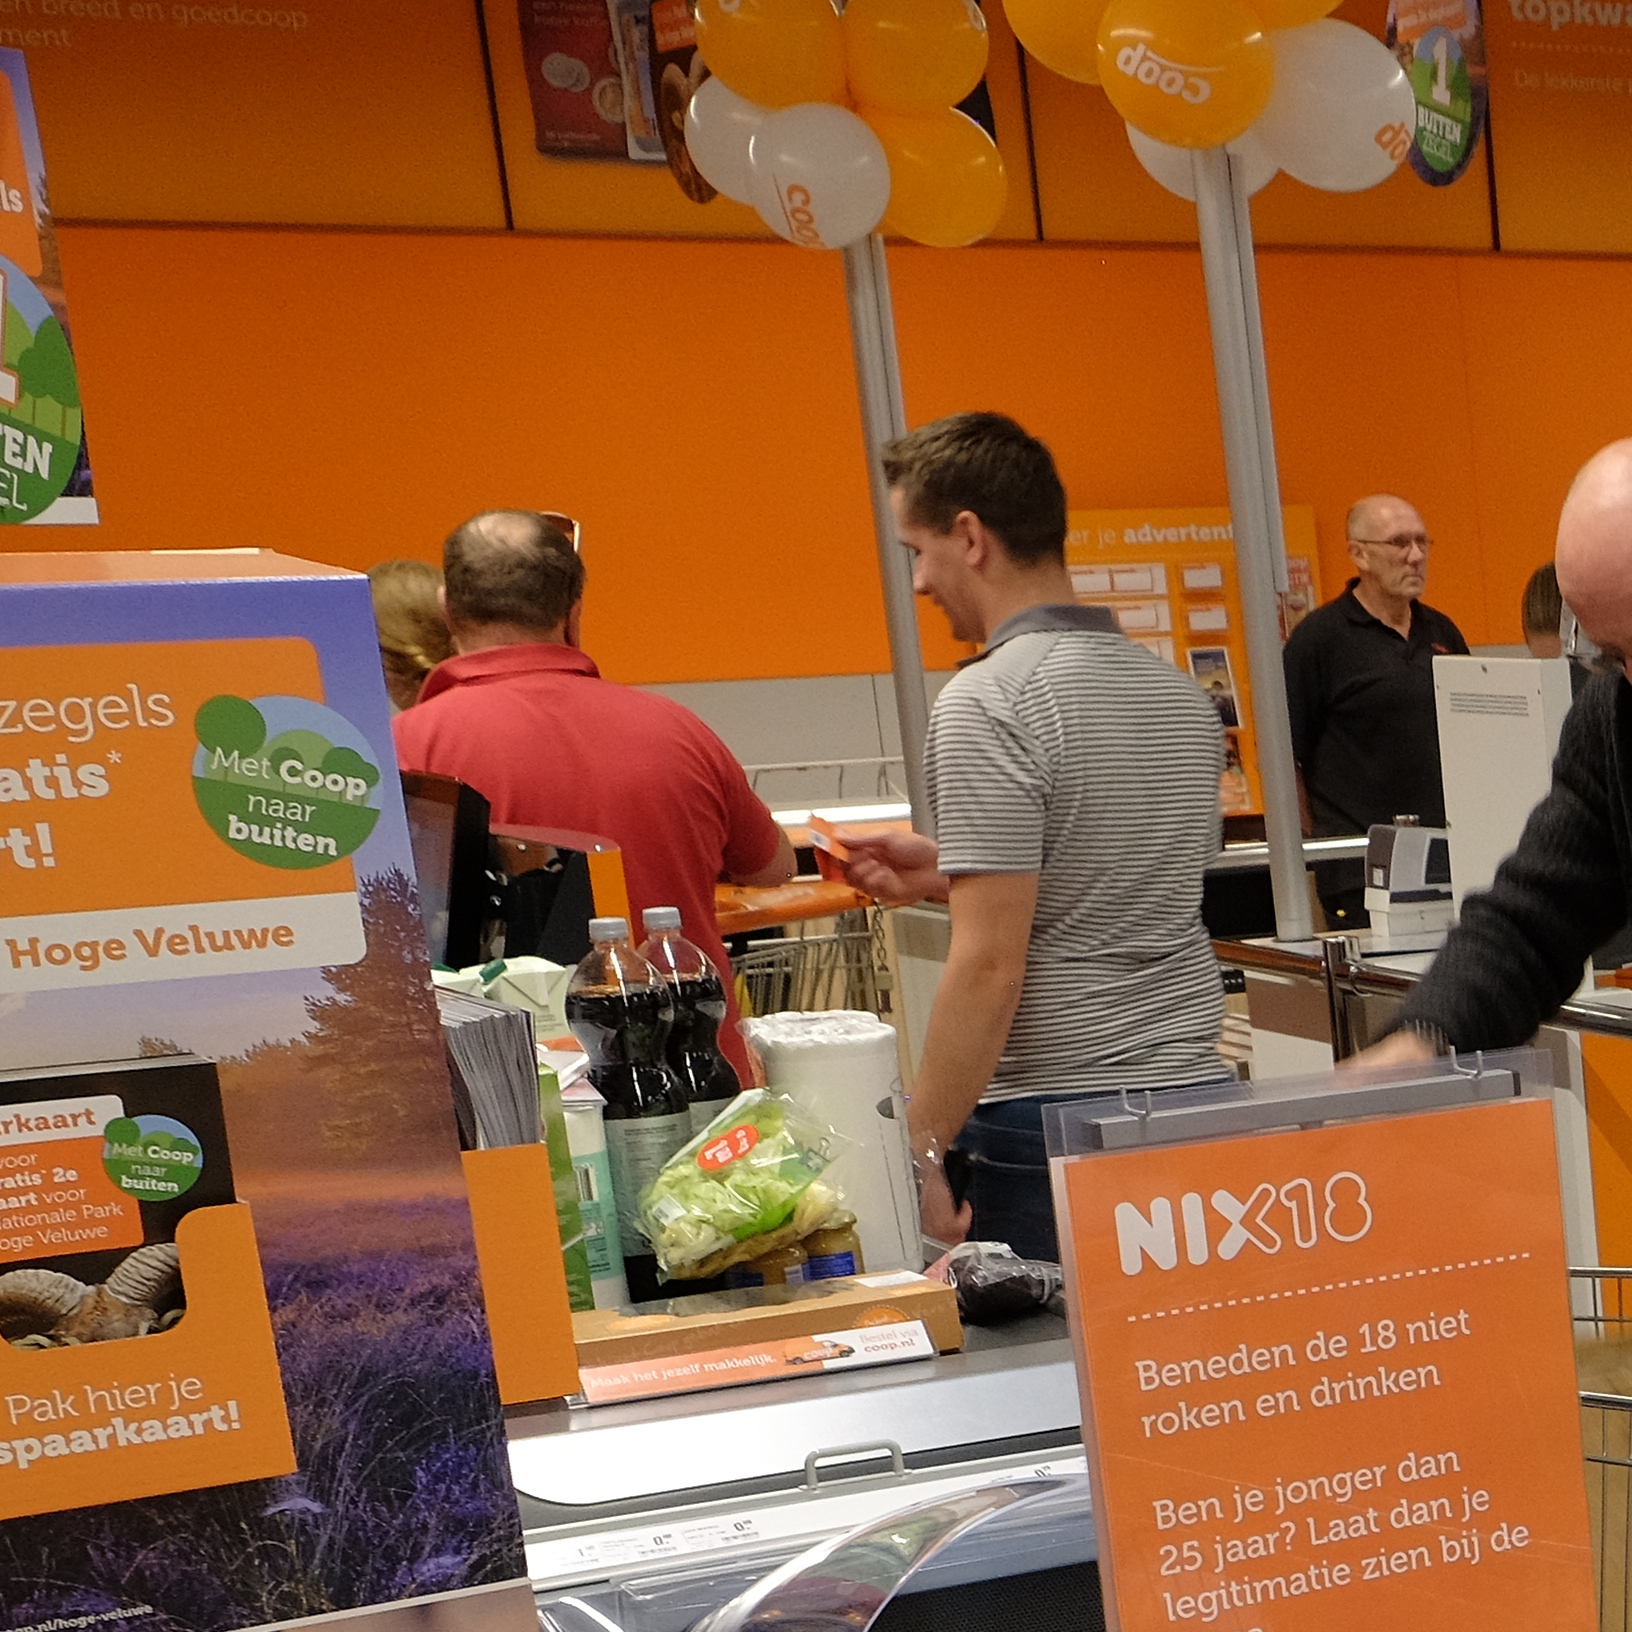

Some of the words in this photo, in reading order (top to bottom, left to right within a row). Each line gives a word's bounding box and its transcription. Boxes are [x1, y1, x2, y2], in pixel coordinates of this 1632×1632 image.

[1116, 42, 1212, 105] coop
[1417, 106, 1461, 146] BUITEN
[211, 746, 271, 780] Met
[278, 758, 369, 802] Coop
[247, 792, 317, 823] naar
[0, 822, 56, 869] t!
[227, 813, 339, 858] buiten
[5, 936, 128, 972] Hoge
[132, 924, 295, 958] Veluwe
[52, 1166, 78, 1183] 2e
[112, 1142, 144, 1158] Met
[147, 1145, 194, 1165] Coop
[130, 1163, 168, 1178] naar
[42, 1188, 88, 1204] voor
[121, 1174, 180, 1193] buiten
[37, 1224, 109, 1245] Veluwe
[82, 1202, 125, 1221] Park
[1113, 1170, 1374, 1277] NIX18
[864, 1338, 916, 1355] coop.nl
[1134, 1340, 1296, 1392] Beneden
[1305, 1329, 1348, 1364] de
[1358, 1319, 1398, 1355] 18
[1405, 1307, 1472, 1347] niet
[588, 1370, 632, 1389] Maak
[633, 1367, 659, 1383] het
[660, 1360, 701, 1381] jezelf
[703, 1353, 778, 1373] makkelijk.
[8, 1391, 77, 1427] Pak
[84, 1377, 161, 1417] hier
[169, 1372, 204, 1406] je
[1140, 1393, 1247, 1439] roken
[1255, 1385, 1301, 1417] en
[1310, 1359, 1441, 1411] drinken
[0, 1400, 242, 1470] spaarkaart!
[1153, 1490, 1225, 1531] Ben
[1231, 1480, 1265, 1524] je
[1274, 1459, 1388, 1515] jonger
[1397, 1449, 1461, 1485] dan
[1159, 1540, 1204, 1578] 25
[1212, 1520, 1297, 1576] jaar?
[1306, 1505, 1380, 1547] Laat
[1390, 1495, 1453, 1530] dan
[1460, 1484, 1491, 1528] je
[1163, 1560, 1351, 1624] legitimatie
[1360, 1544, 1431, 1583] zien
[1439, 1530, 1481, 1571] bij
[1489, 1521, 1530, 1554] de
